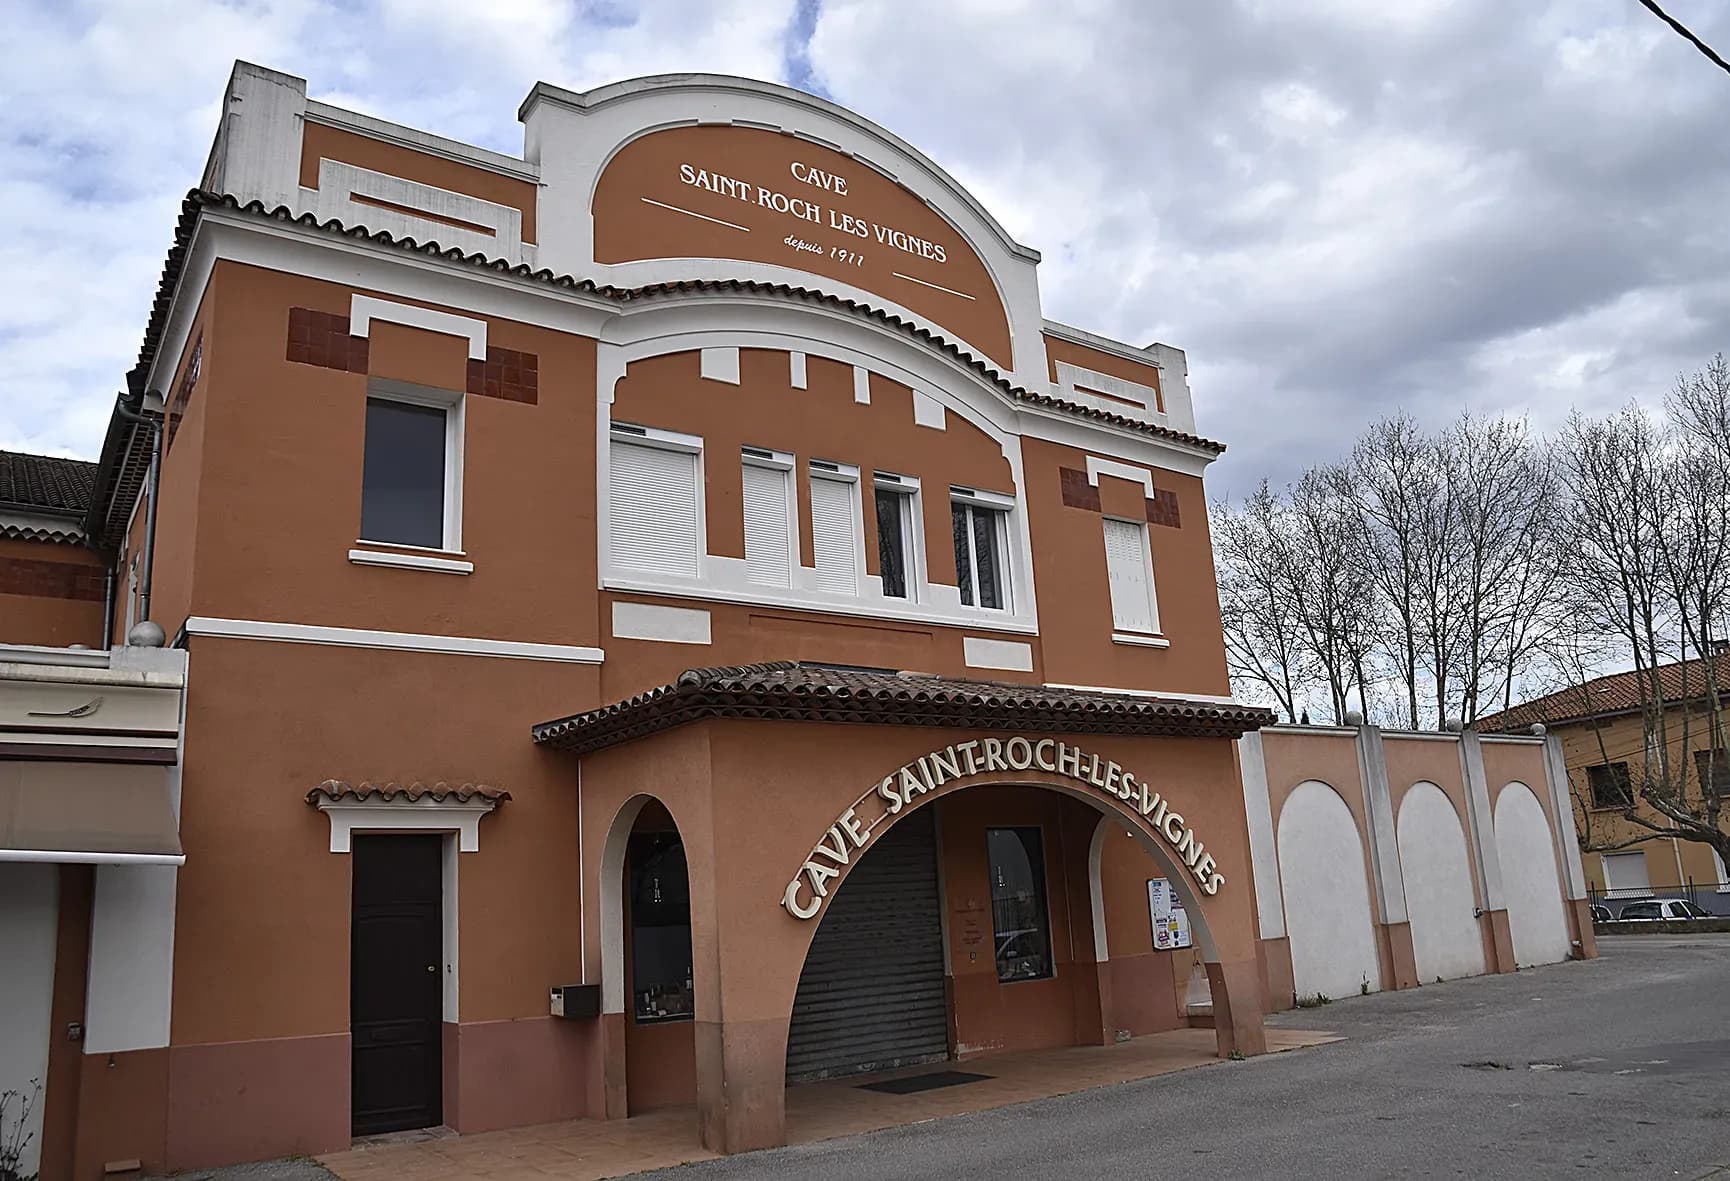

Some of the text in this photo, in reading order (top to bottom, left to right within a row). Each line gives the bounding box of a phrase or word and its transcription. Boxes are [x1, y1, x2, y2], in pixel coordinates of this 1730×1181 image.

[790, 162, 848, 196] CAVE
[784, 234, 865, 268] depuis 1911
[829, 210, 869, 239] LES
[873, 223, 947, 263] VIGNES
[782, 807, 872, 921] CAVE
